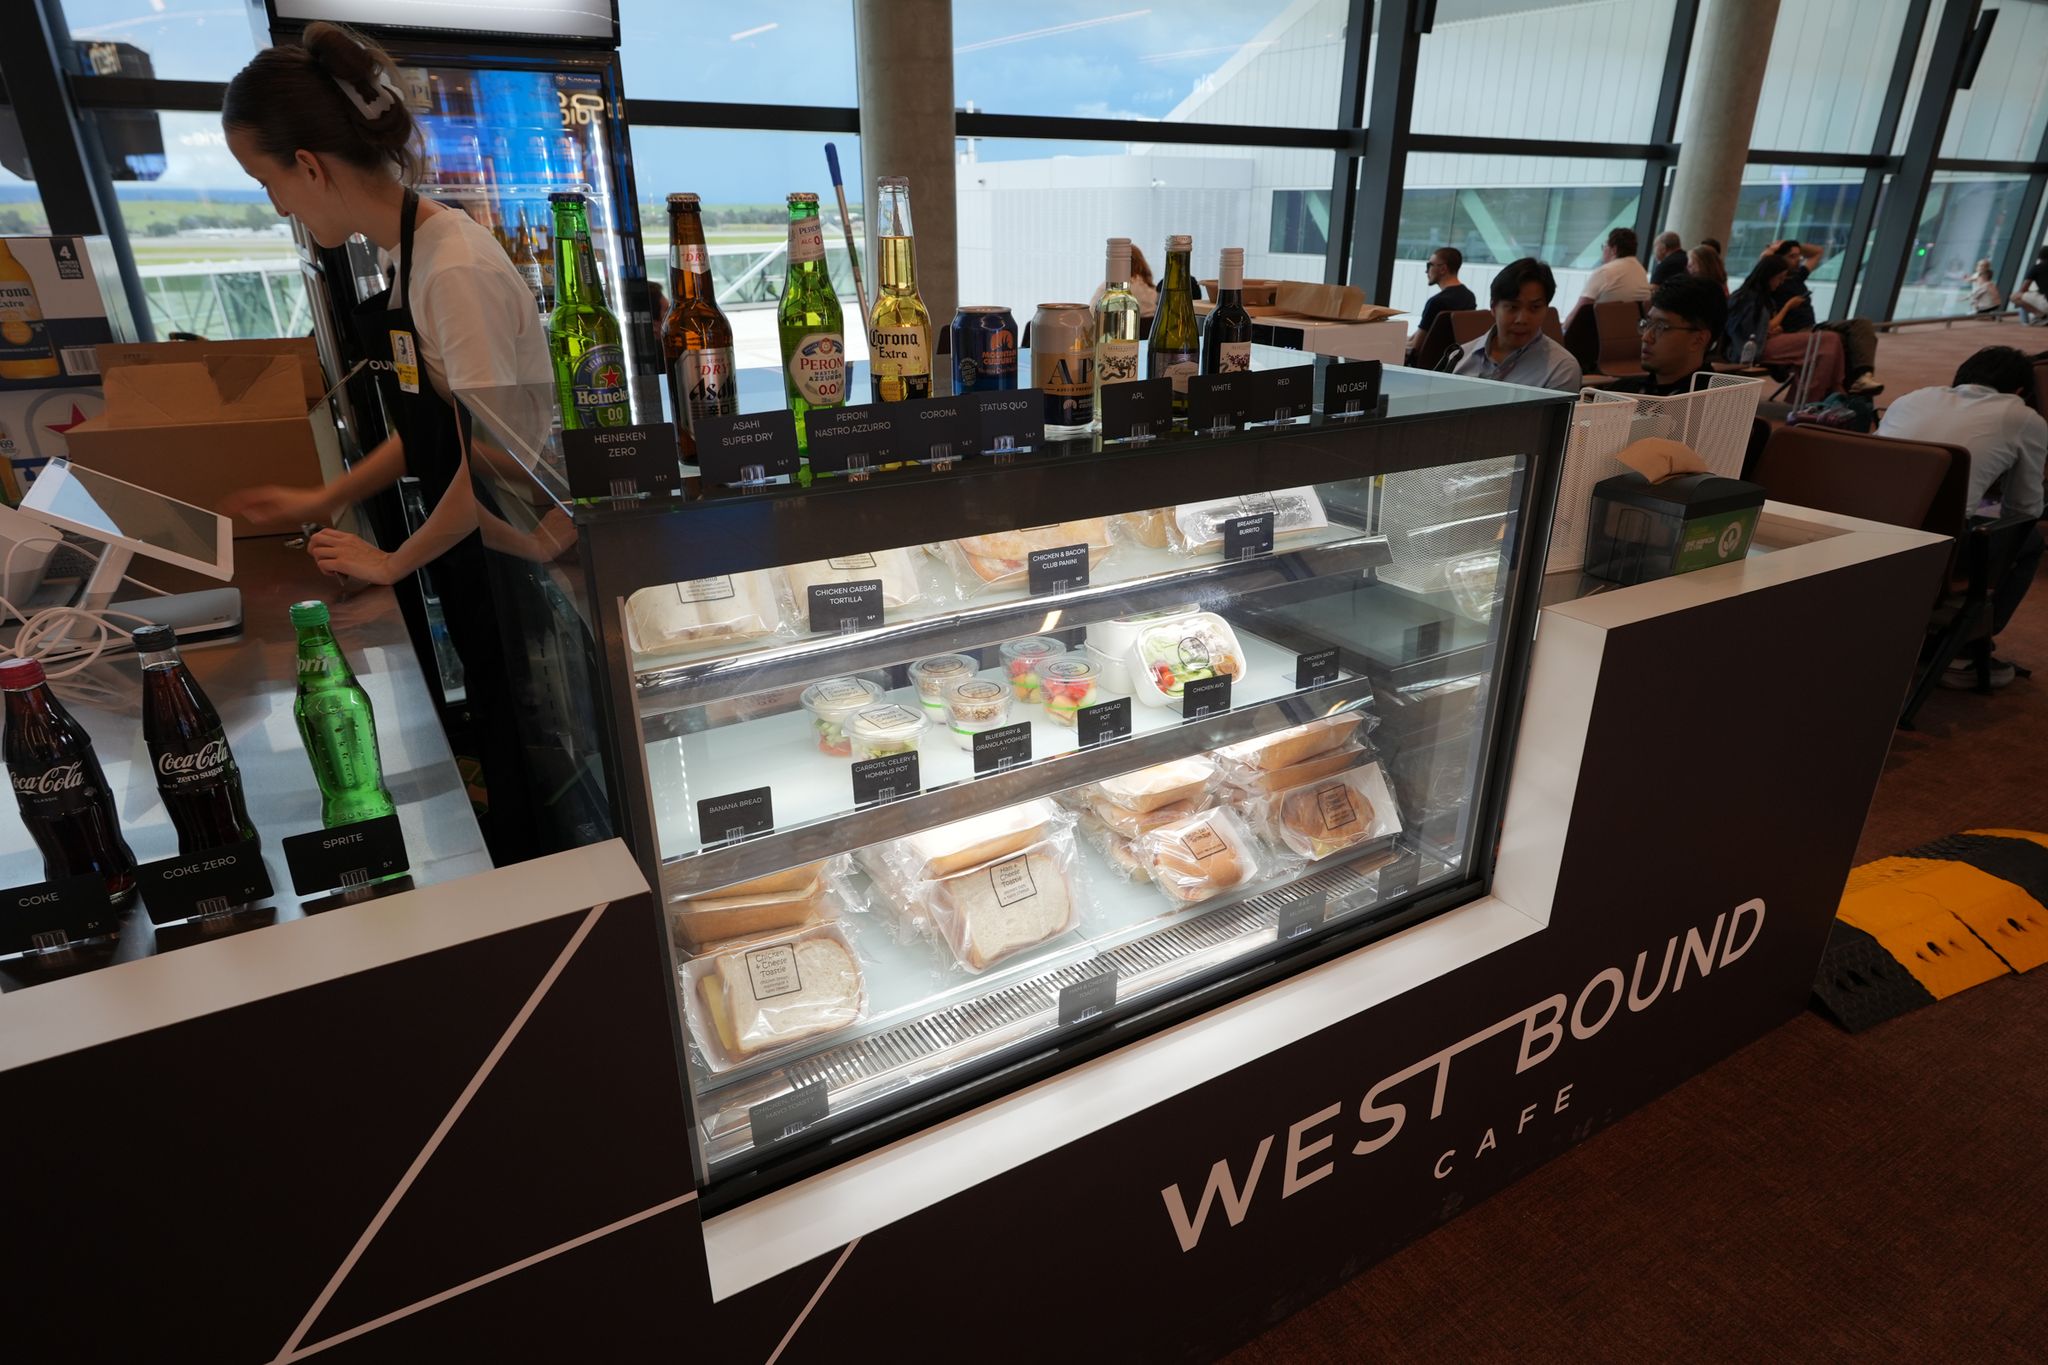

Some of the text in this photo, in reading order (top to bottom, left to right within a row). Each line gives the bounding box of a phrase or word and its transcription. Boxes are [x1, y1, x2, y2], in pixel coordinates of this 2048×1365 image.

[60, 245, 71, 259] 4
[869, 328, 918, 347] Corona
[879, 346, 908, 359] Extra
[1211, 384, 1232, 392] WHITE
[1277, 378, 1291, 386] RED
[1337, 381, 1368, 394] NO CASH
[818, 384, 837, 396] 0.0
[1009, 400, 1028, 411] QUO
[836, 411, 868, 422] PERONI
[920, 409, 957, 420] CORONA
[732, 420, 761, 431] ASAHI
[815, 421, 891, 438] NASTRO AZZURRO
[594, 431, 646, 445] HEINEKEN
[722, 432, 774, 447] SUPER DRY
[608, 446, 637, 458] ZERO
[1236, 517, 1263, 528] BREAKFAST
[1239, 527, 1261, 536] BURRITO
[1032, 553, 1060, 562] CHICKEN
[1065, 548, 1086, 557] BACON
[1042, 558, 1078, 570] CLUB PANINI
[815, 584, 877, 597] CHICKEN CAESAR
[830, 595, 863, 605] TORTILLA
[1104, 703, 1121, 712] SALAD
[1100, 713, 1111, 721] POT
[985, 730, 1016, 741] BLUEBERRY
[975, 733, 1031, 751] GRANOLA YOGHURT
[159, 736, 230, 776] Coca-Cola
[888, 755, 911, 766] CELERY
[176, 765, 225, 784] zero sugar
[865, 764, 908, 780] HOMMUS POT
[709, 797, 763, 814] BANANA BREAD
[322, 832, 364, 849] SPRITE
[162, 855, 237, 880] COKE ZERO
[18, 891, 60, 908] COKE
[756, 951, 785, 963] Chicken
[762, 958, 787, 969] Cheese
[760, 966, 787, 978] Toastie
[1161, 897, 1766, 1253] WEST BOUND
[1434, 1084, 1574, 1180] CAFE
